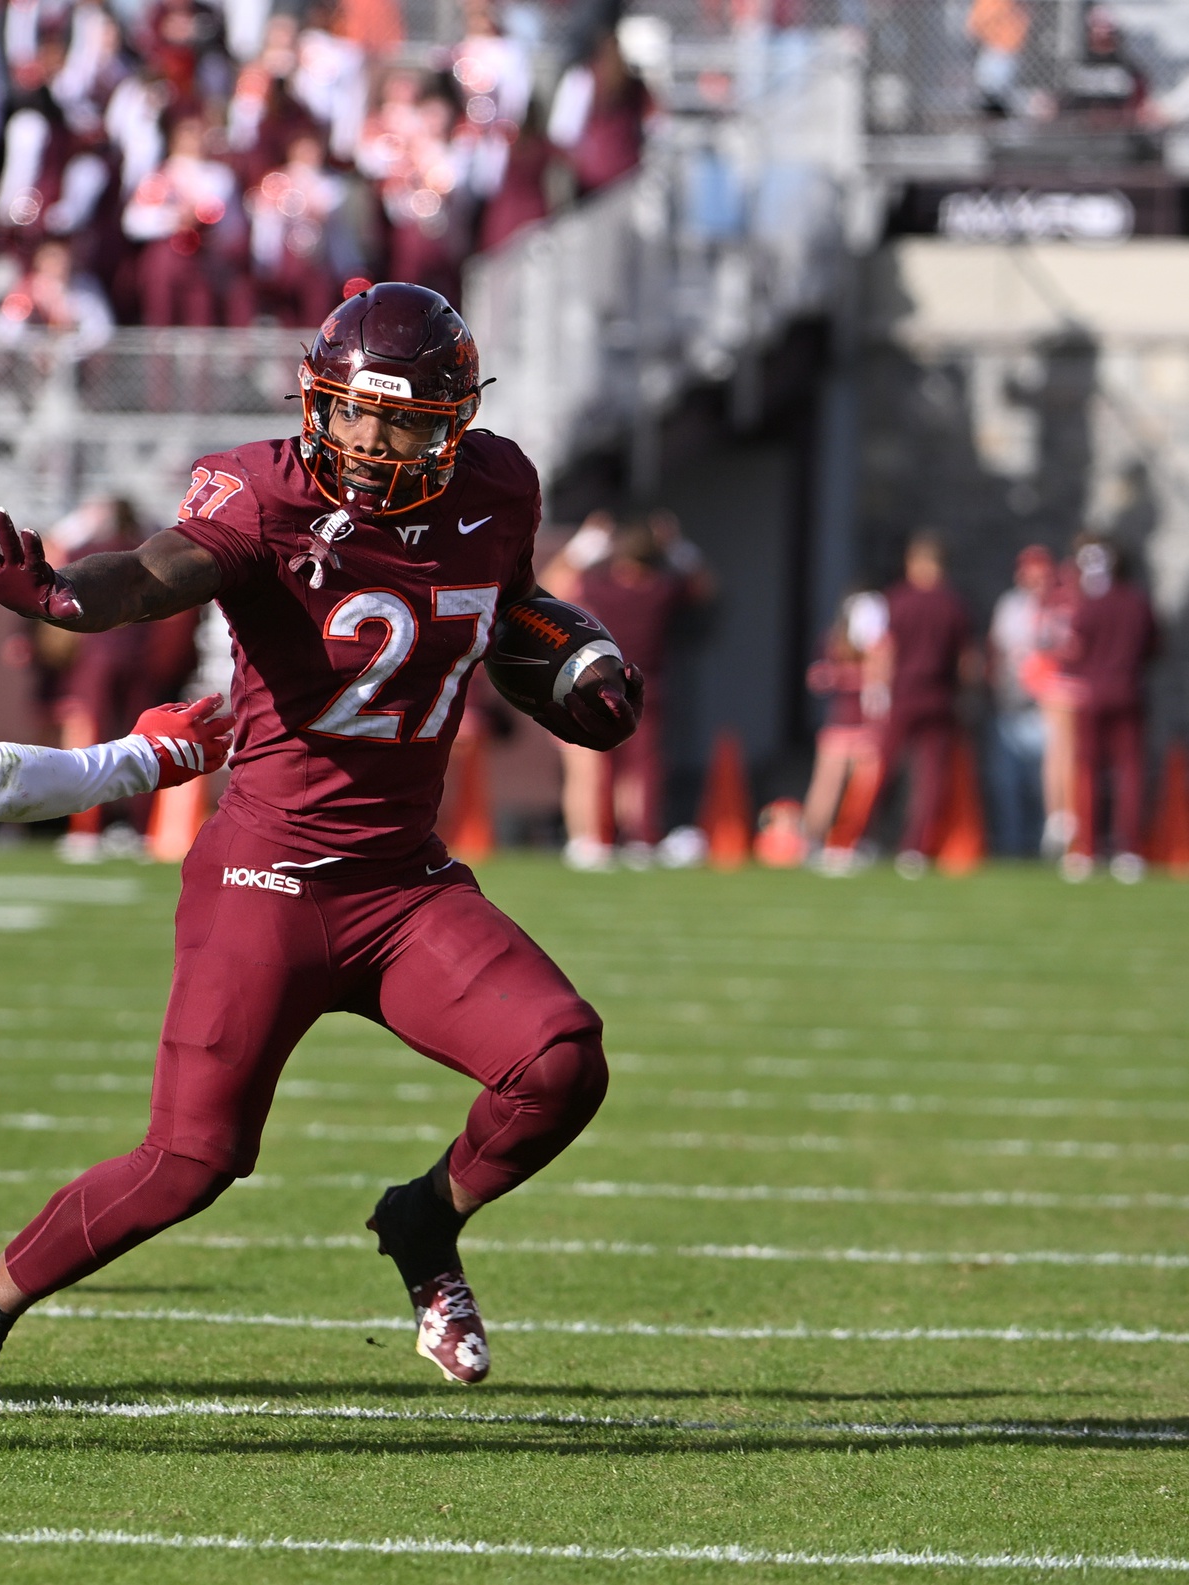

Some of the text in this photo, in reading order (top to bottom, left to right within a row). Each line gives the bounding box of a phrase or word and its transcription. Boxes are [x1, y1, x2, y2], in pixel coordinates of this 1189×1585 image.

[368, 377, 401, 391] TECH
[178, 466, 243, 522] 27
[320, 509, 350, 544] NXTRND
[395, 525, 429, 545] VT
[299, 581, 501, 744] 27
[222, 867, 301, 895] HOKIES
